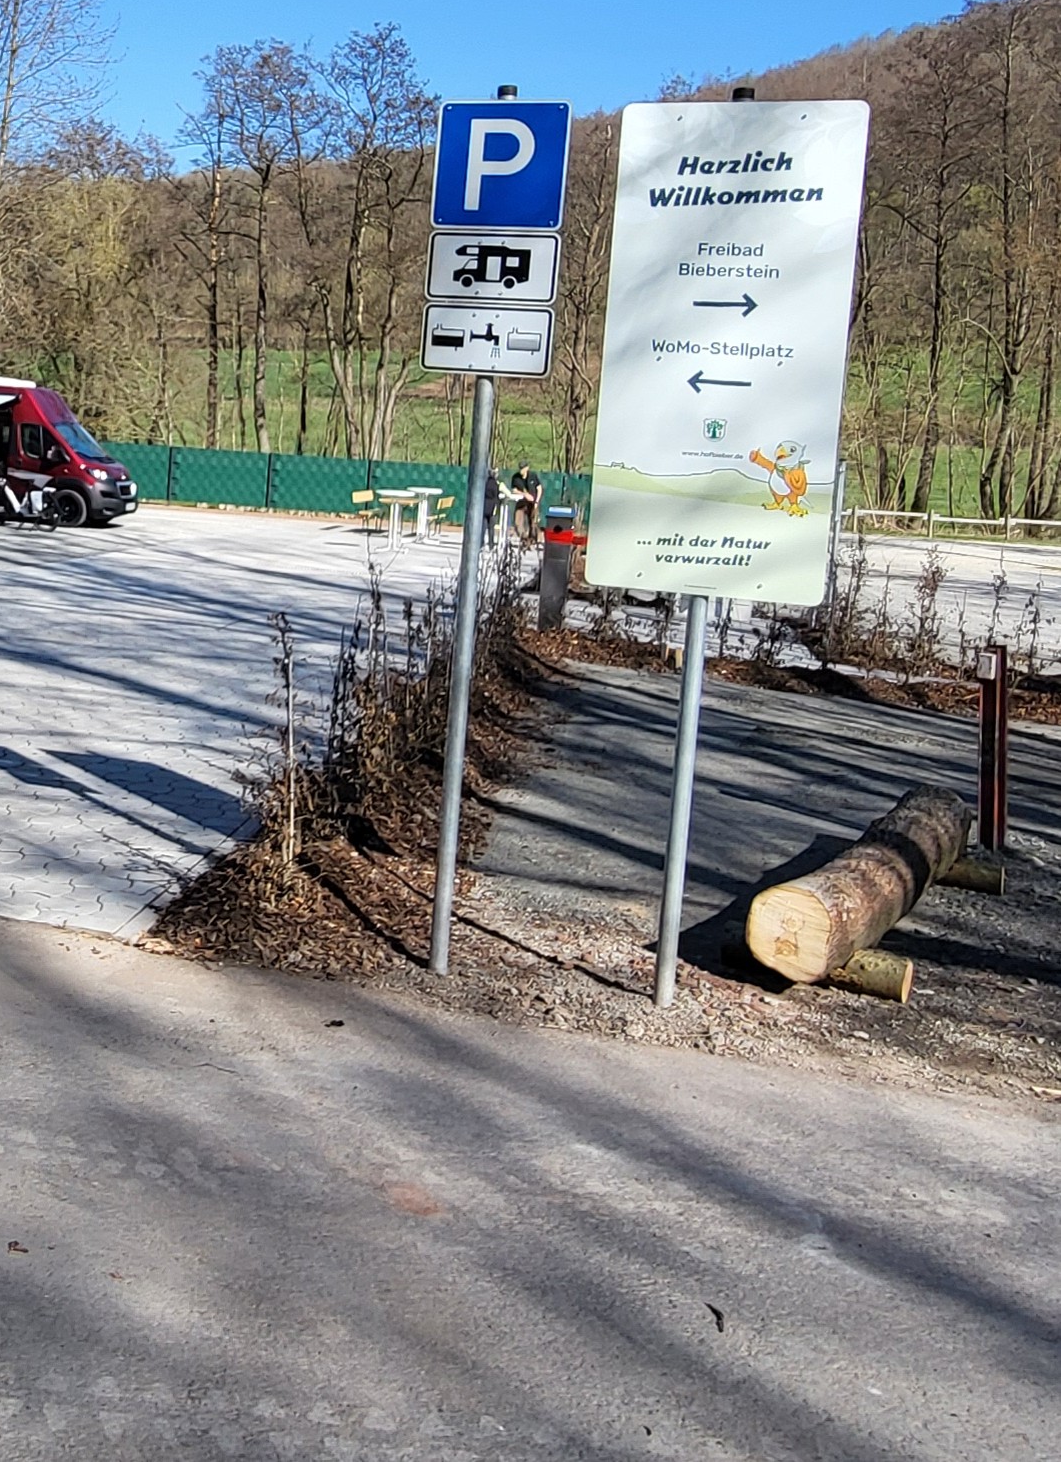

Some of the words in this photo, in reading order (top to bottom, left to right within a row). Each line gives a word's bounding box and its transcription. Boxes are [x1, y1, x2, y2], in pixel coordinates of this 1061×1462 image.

[463, 118, 536, 211] P
[677, 150, 793, 176] Herzlich
[649, 185, 824, 208] Willkommen
[697, 242, 765, 258] Freibad
[678, 263, 780, 279] Bieberstein
[651, 339, 795, 360] WoMo-Stellplatz
[656, 533, 684, 547] mit
[688, 535, 718, 548] der
[720, 536, 772, 550] Natur
[655, 554, 752, 567] verwurzelt!
